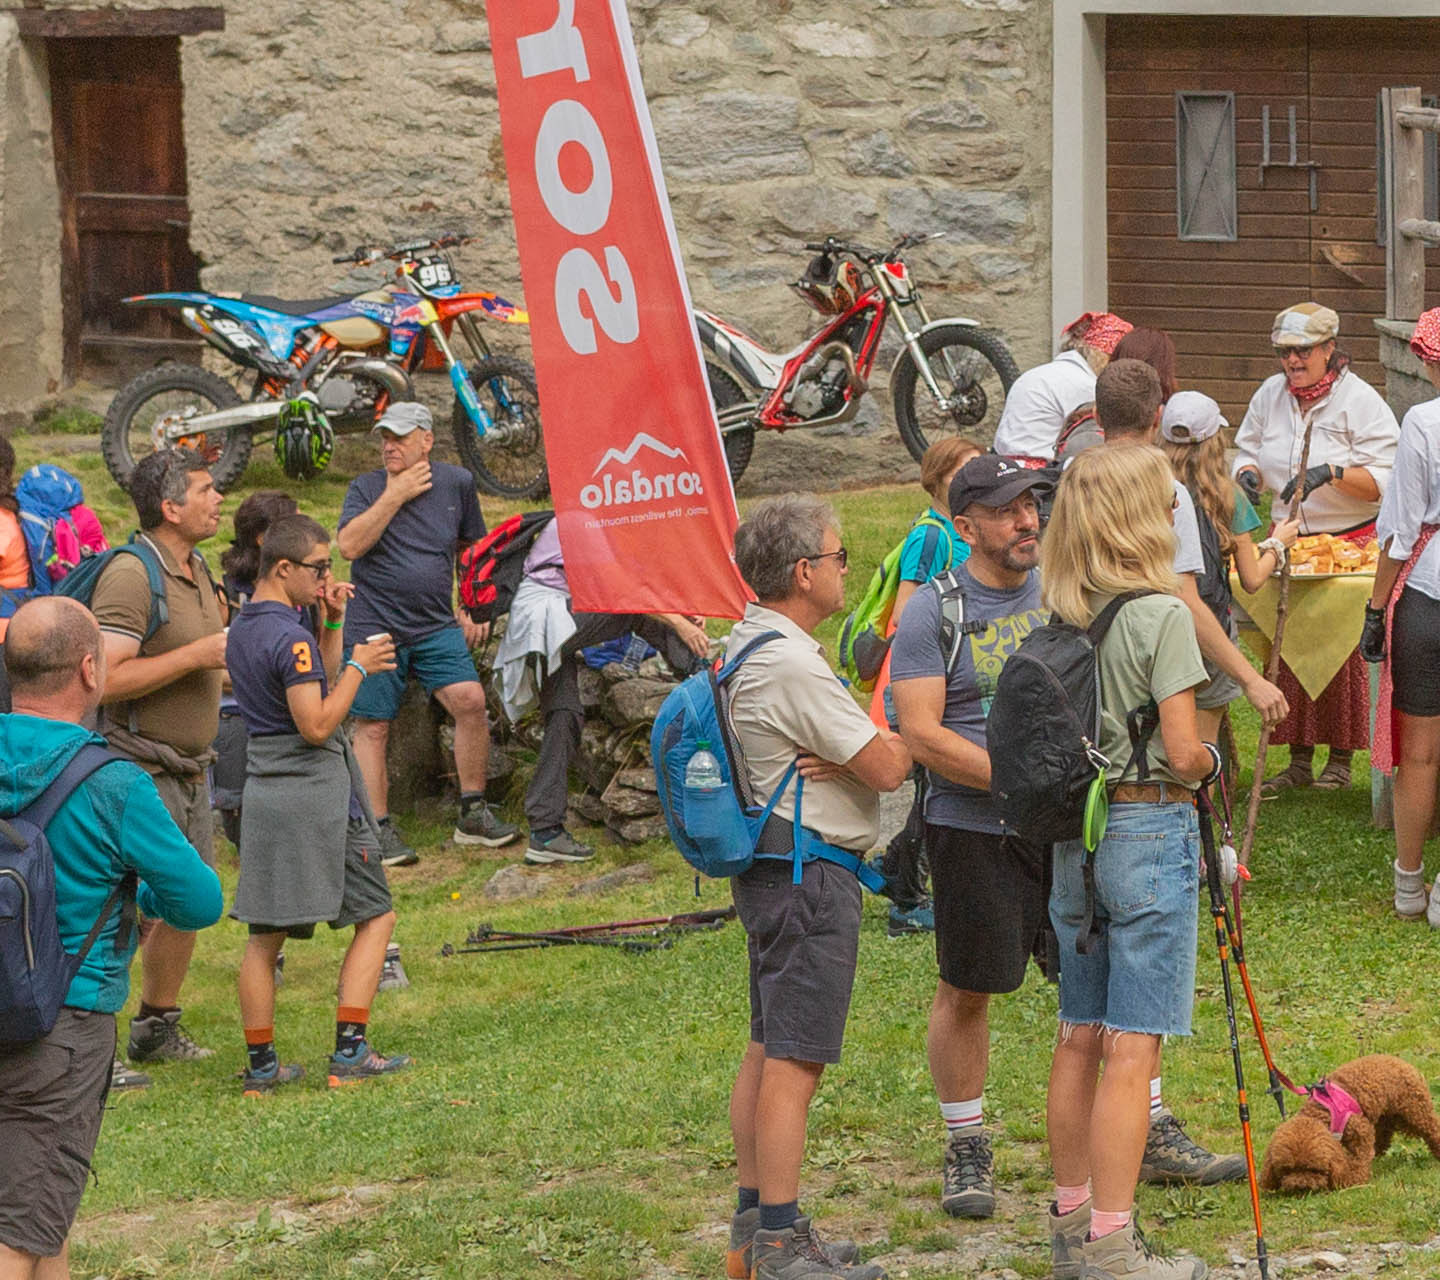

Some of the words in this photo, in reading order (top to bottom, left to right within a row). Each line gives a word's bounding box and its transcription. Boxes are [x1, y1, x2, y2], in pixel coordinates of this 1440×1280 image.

[419, 263, 452, 288] 96
[352, 300, 394, 318] GoPro
[292, 641, 312, 673] 3
